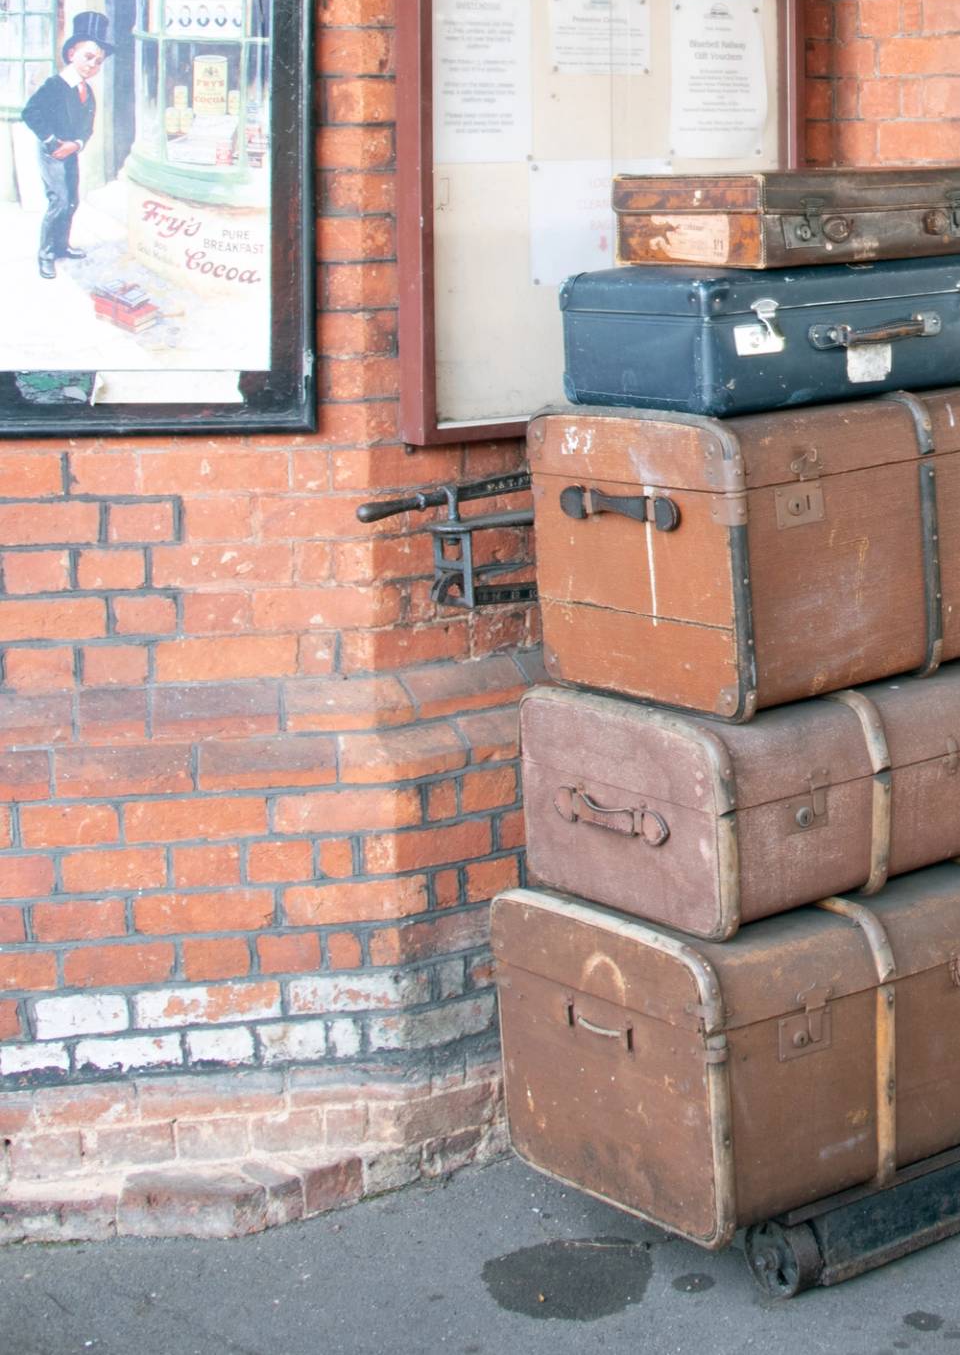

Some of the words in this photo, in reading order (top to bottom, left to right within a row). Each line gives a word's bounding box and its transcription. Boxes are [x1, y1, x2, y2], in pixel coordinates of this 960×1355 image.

[142, 200, 202, 238] Fry's
[203, 238, 264, 254] BREAKFAST
[222, 229, 250, 240] PURE
[185, 248, 261, 284] Cocoa
